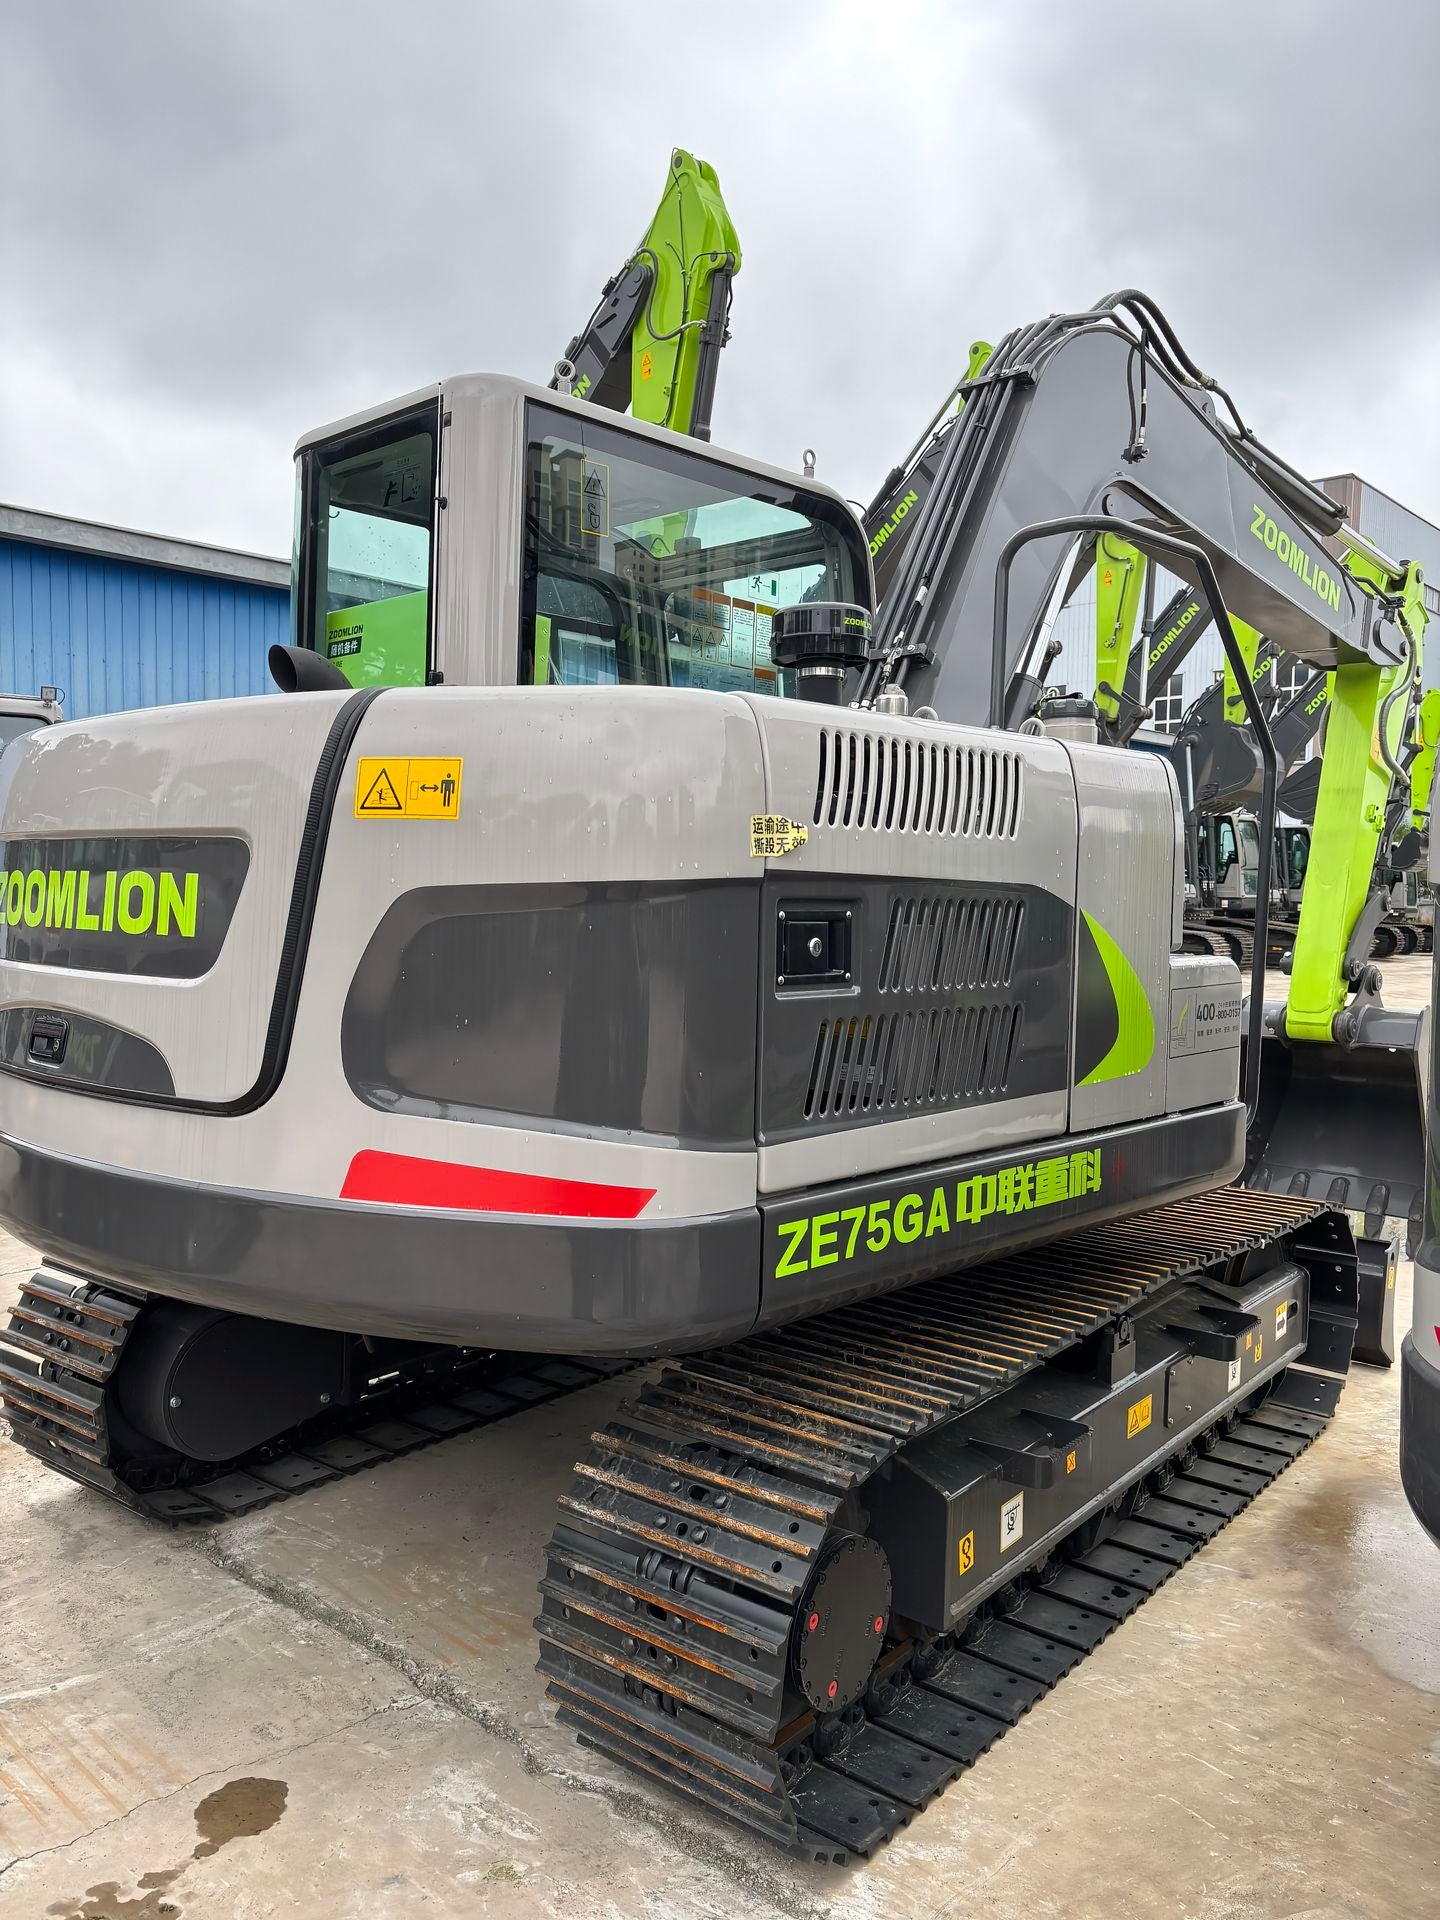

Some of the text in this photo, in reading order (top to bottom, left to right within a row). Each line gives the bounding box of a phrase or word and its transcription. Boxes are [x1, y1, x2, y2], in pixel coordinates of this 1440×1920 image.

[1250, 503, 1342, 613] ZOOMLION
[328, 624, 364, 640] ZOOMLION
[1196, 1003, 1216, 1022] 400
[775, 1148, 1102, 1279] ZE75GA 中联重科
